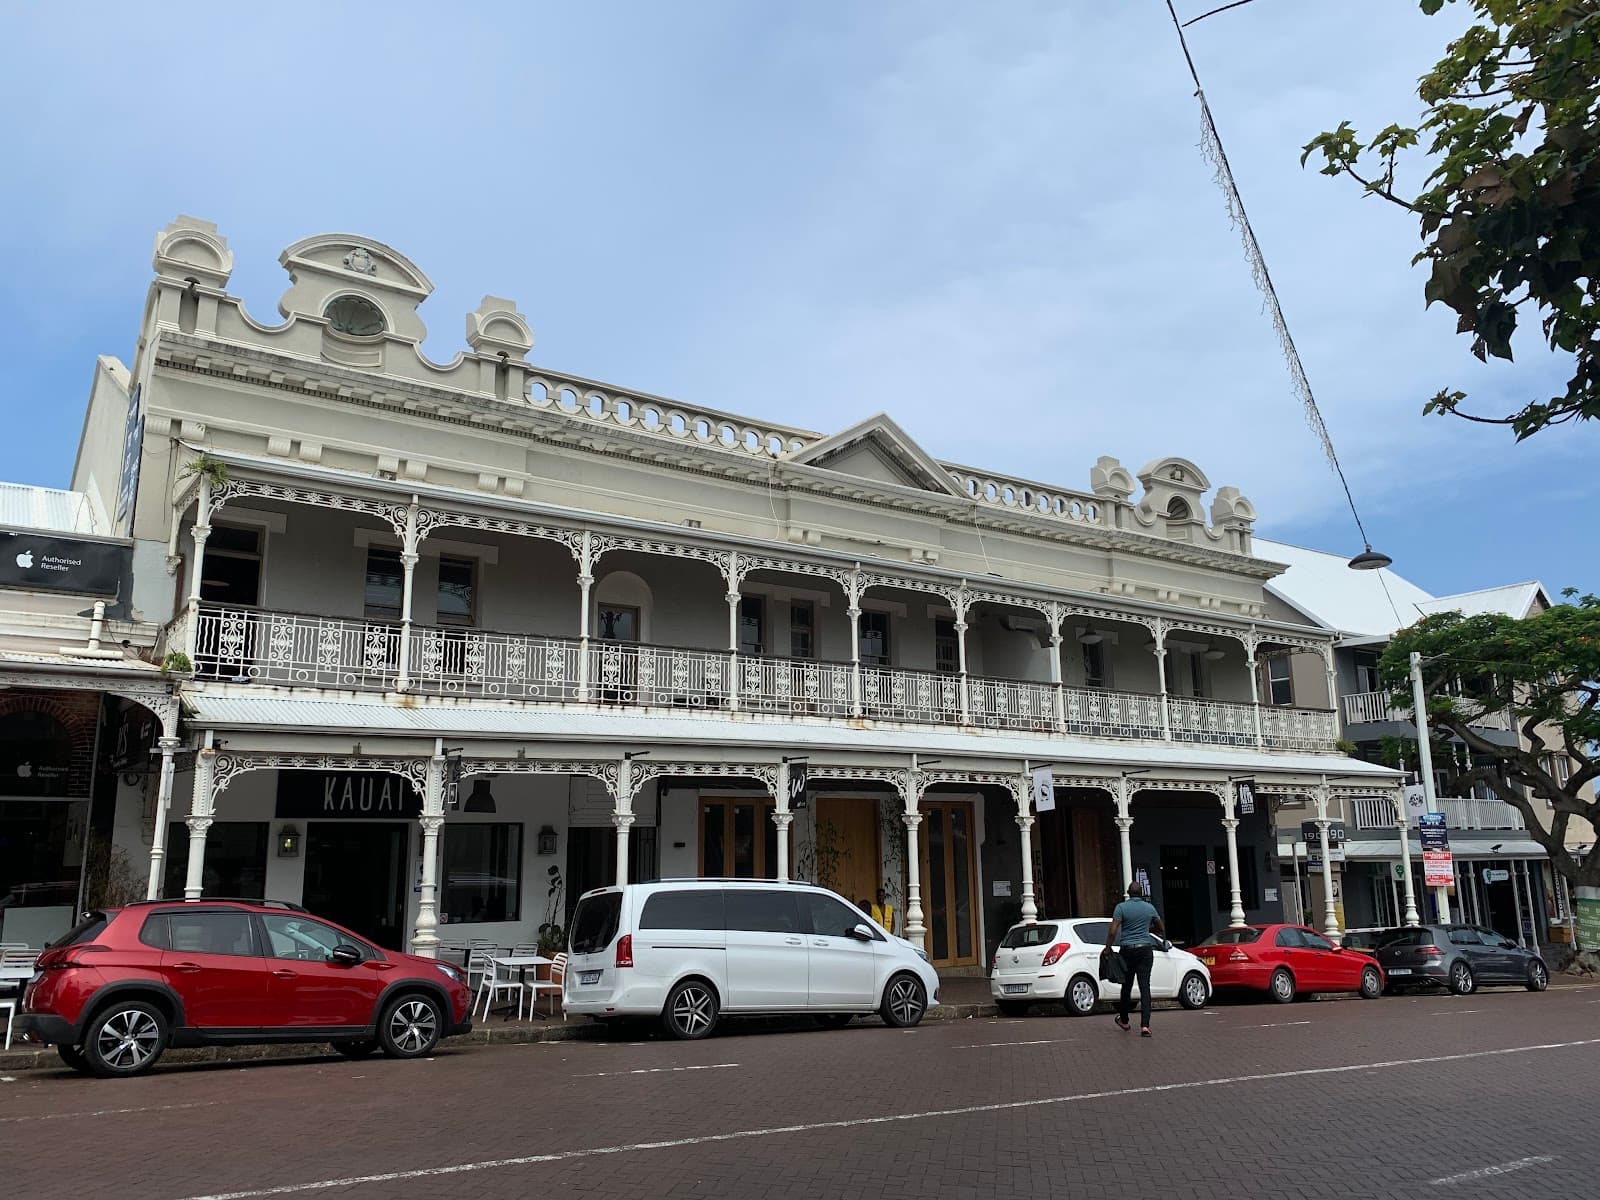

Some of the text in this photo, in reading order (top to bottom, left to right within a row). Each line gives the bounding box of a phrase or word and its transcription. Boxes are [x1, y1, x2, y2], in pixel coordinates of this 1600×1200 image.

[41, 555, 82, 567] Authorised
[41, 562, 70, 572] Reseller
[323, 776, 404, 812] KAUAI
